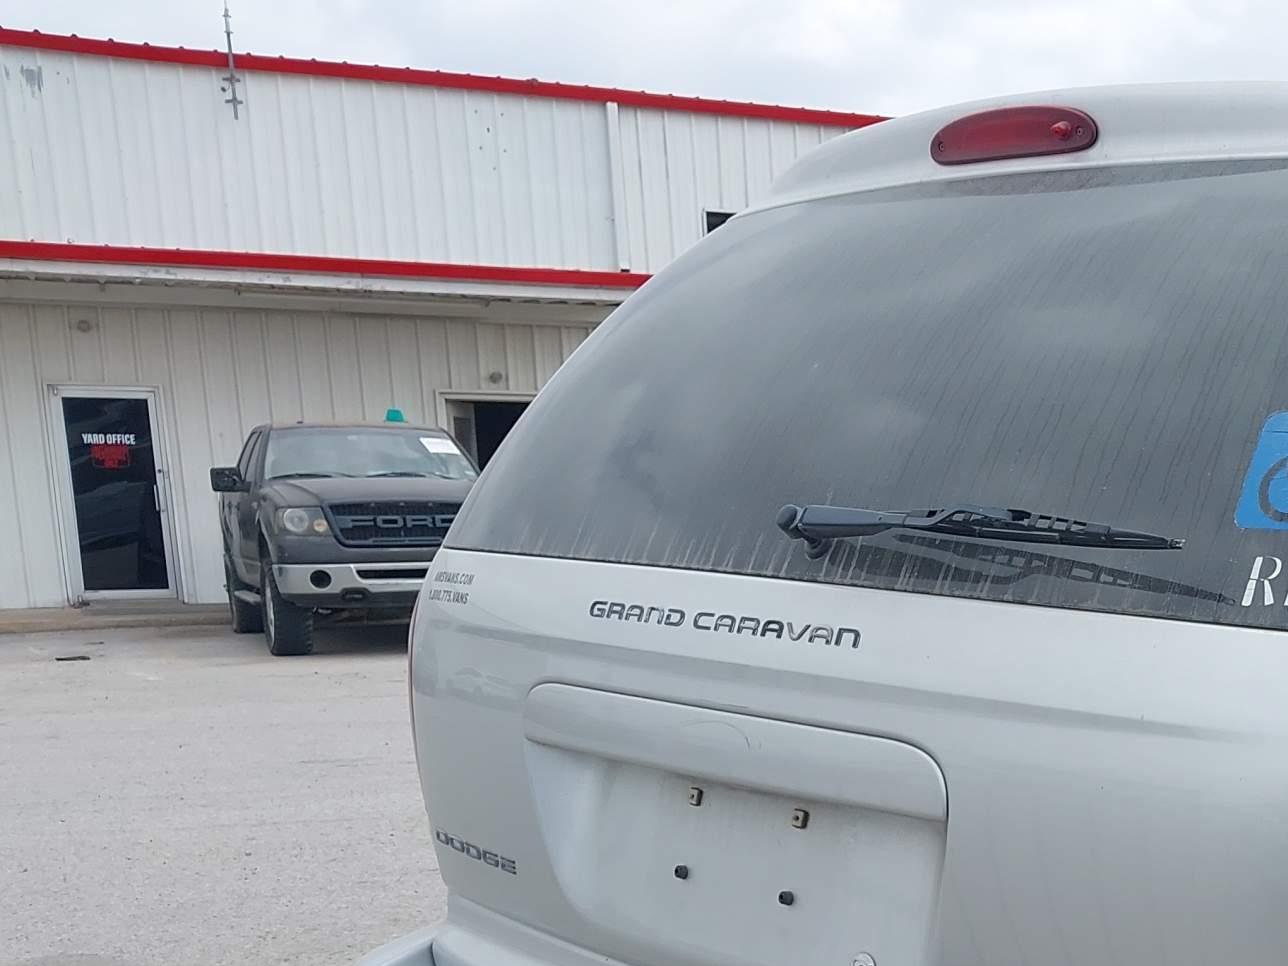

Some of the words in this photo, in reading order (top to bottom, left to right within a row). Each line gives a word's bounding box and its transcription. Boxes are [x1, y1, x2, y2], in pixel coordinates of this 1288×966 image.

[82, 433, 105, 444] YARD
[106, 433, 136, 445] OFFICE
[589, 600, 685, 627] GRAND
[693, 612, 861, 648] CARAVAN
[436, 830, 517, 875] DODGE
